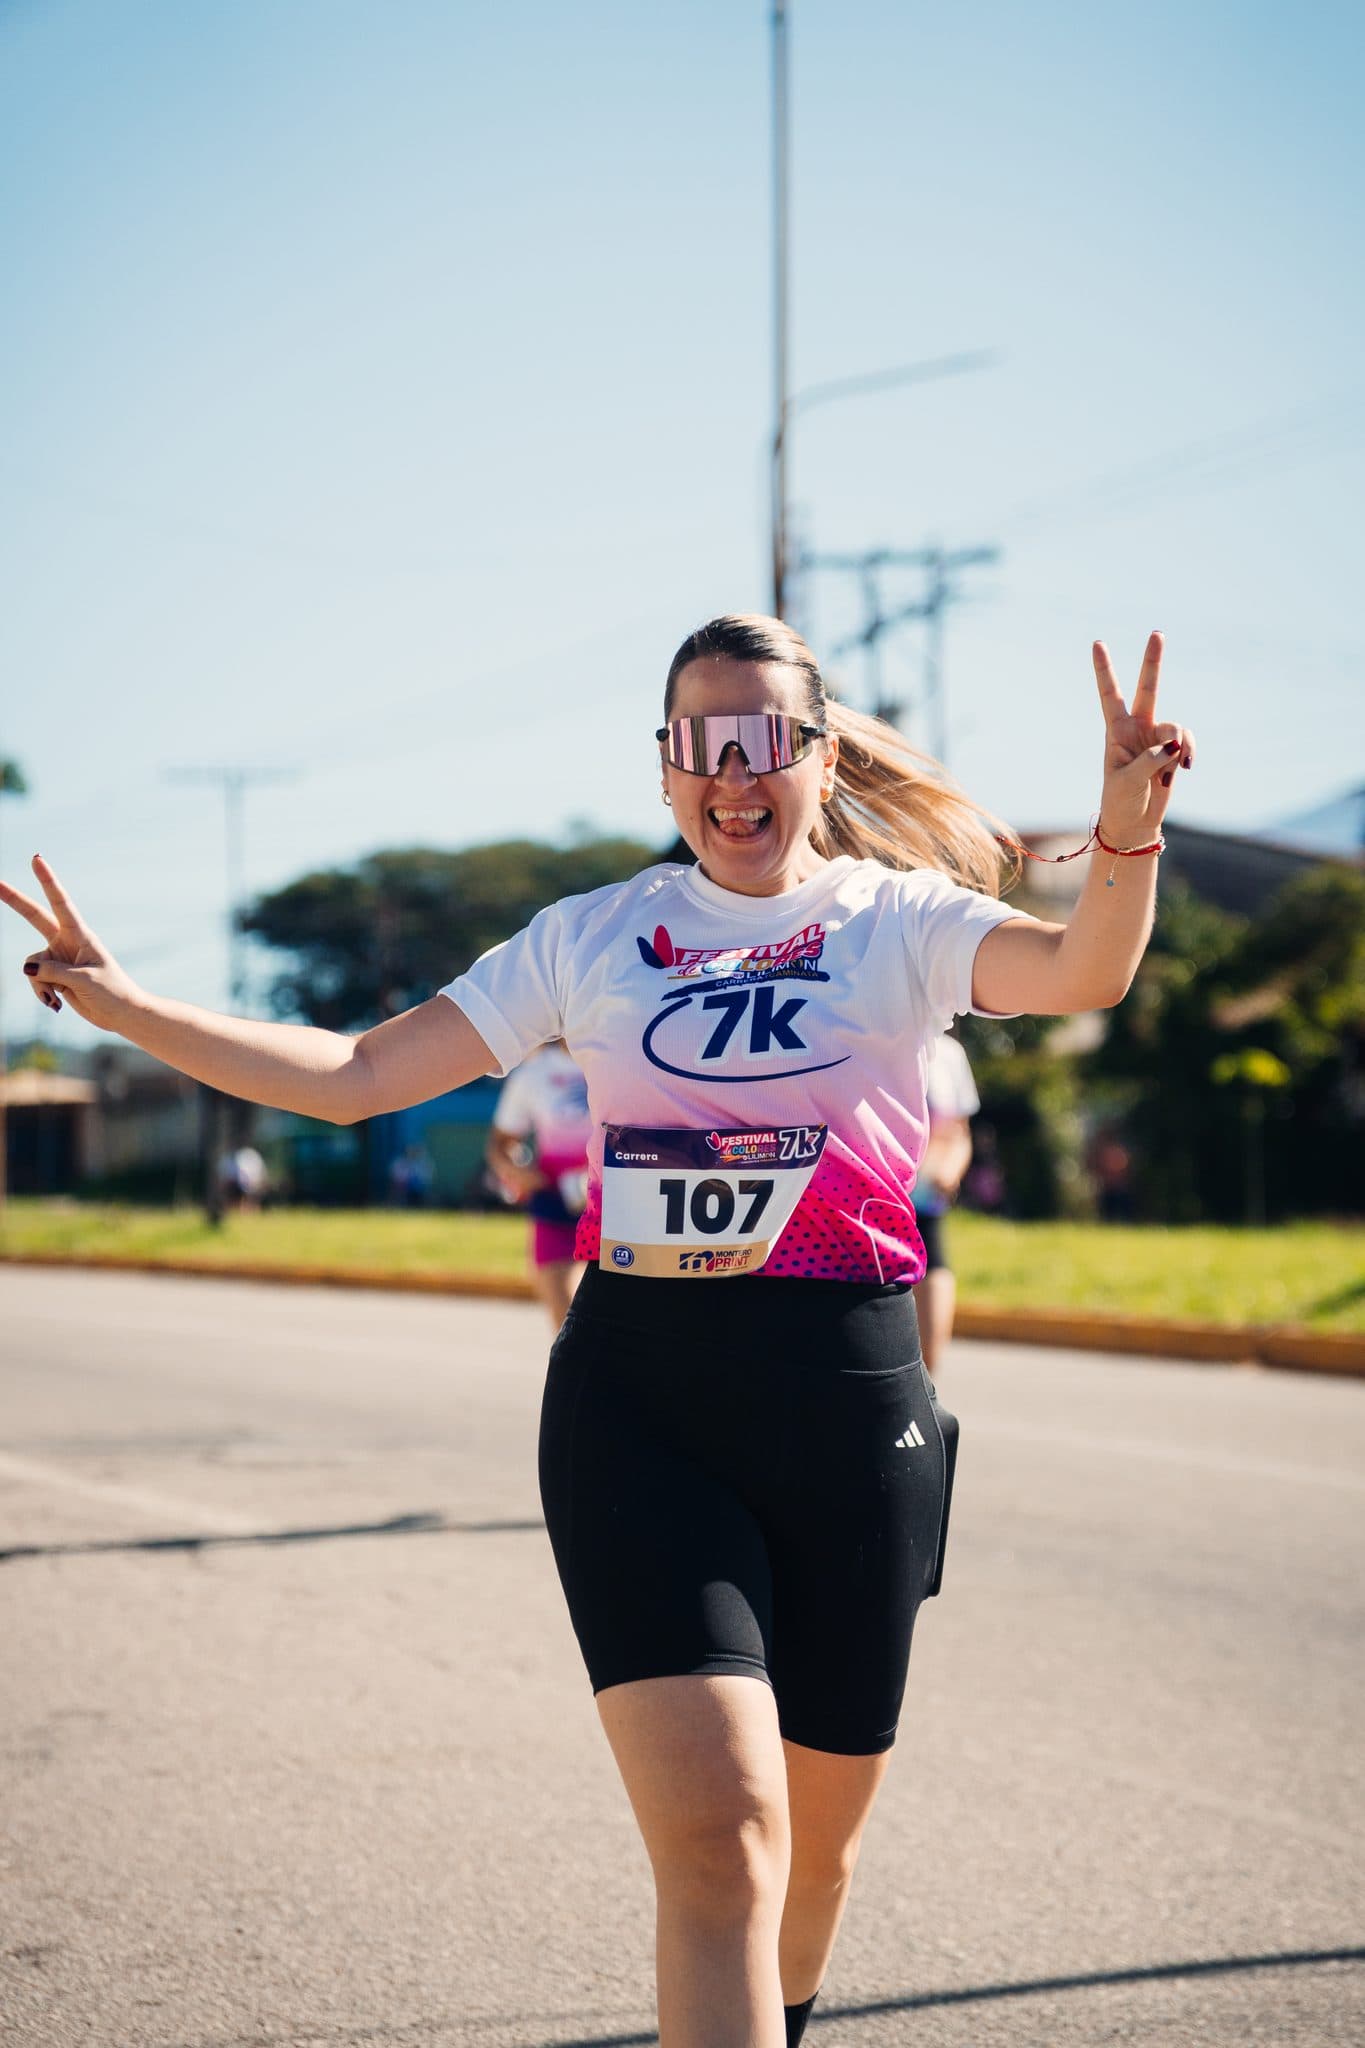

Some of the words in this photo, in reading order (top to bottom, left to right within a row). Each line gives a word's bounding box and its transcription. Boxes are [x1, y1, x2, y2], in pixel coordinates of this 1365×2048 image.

[680, 925, 824, 964] FESTIVAL
[721, 1133, 777, 1147] FESTIVAL
[732, 1143, 777, 1155] COLORES
[615, 1151, 659, 1161] Carrera
[659, 1178, 775, 1235] 107
[715, 1256, 750, 1268] PRINT
